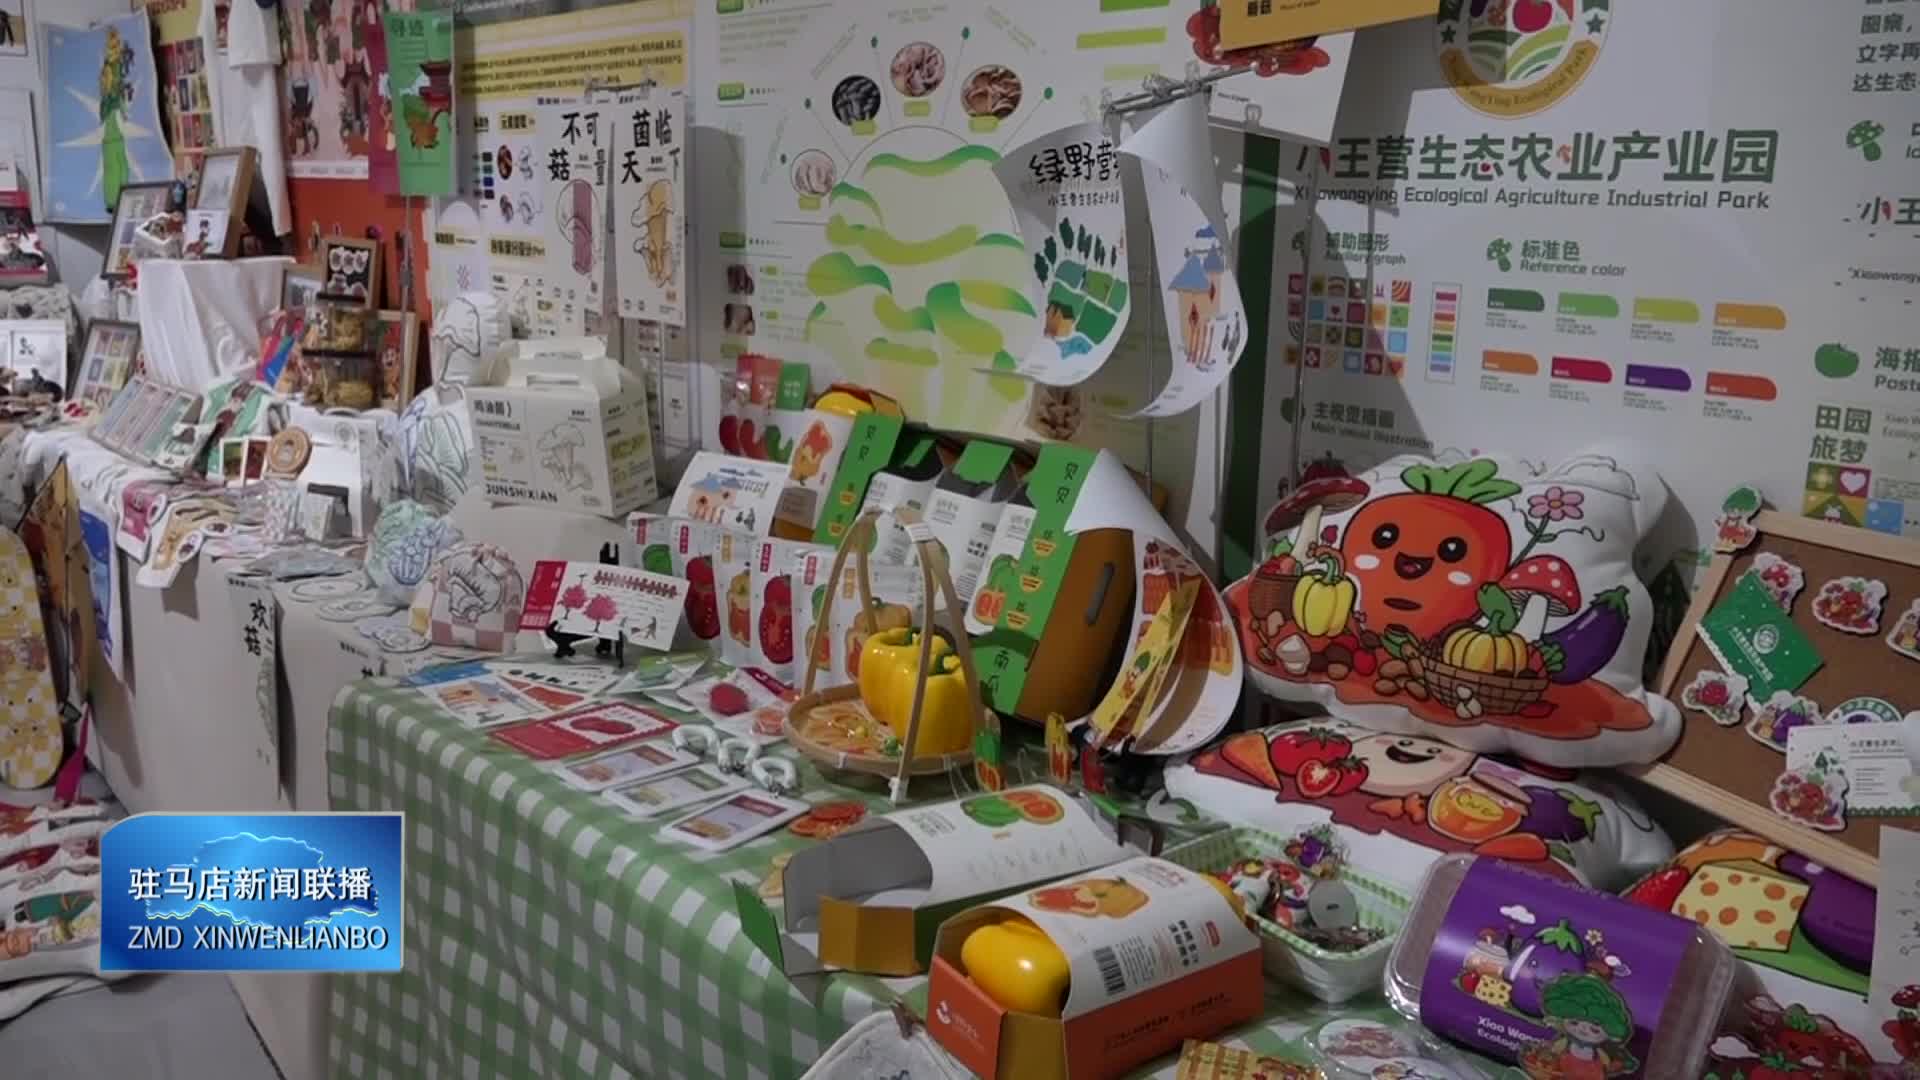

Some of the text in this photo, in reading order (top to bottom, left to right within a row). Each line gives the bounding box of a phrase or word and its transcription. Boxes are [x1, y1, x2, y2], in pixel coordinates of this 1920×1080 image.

[562, 112, 599, 146] 不可
[548, 149, 570, 181] 菇
[1028, 140, 1119, 184] 绿野营
[1404, 187, 1488, 207] Ecological
[1495, 188, 1599, 208] Agriculture
[1607, 189, 1708, 207] Industrial
[1717, 191, 1770, 210] Park
[1521, 239, 1582, 262] 标准色
[1519, 259, 1627, 278] Reference color
[1816, 404, 1873, 434] 田园
[1810, 435, 1869, 464] 旅梦
[485, 484, 558, 504] JUNSHIXIAN
[1478, 1015, 1505, 1033] Xiao
